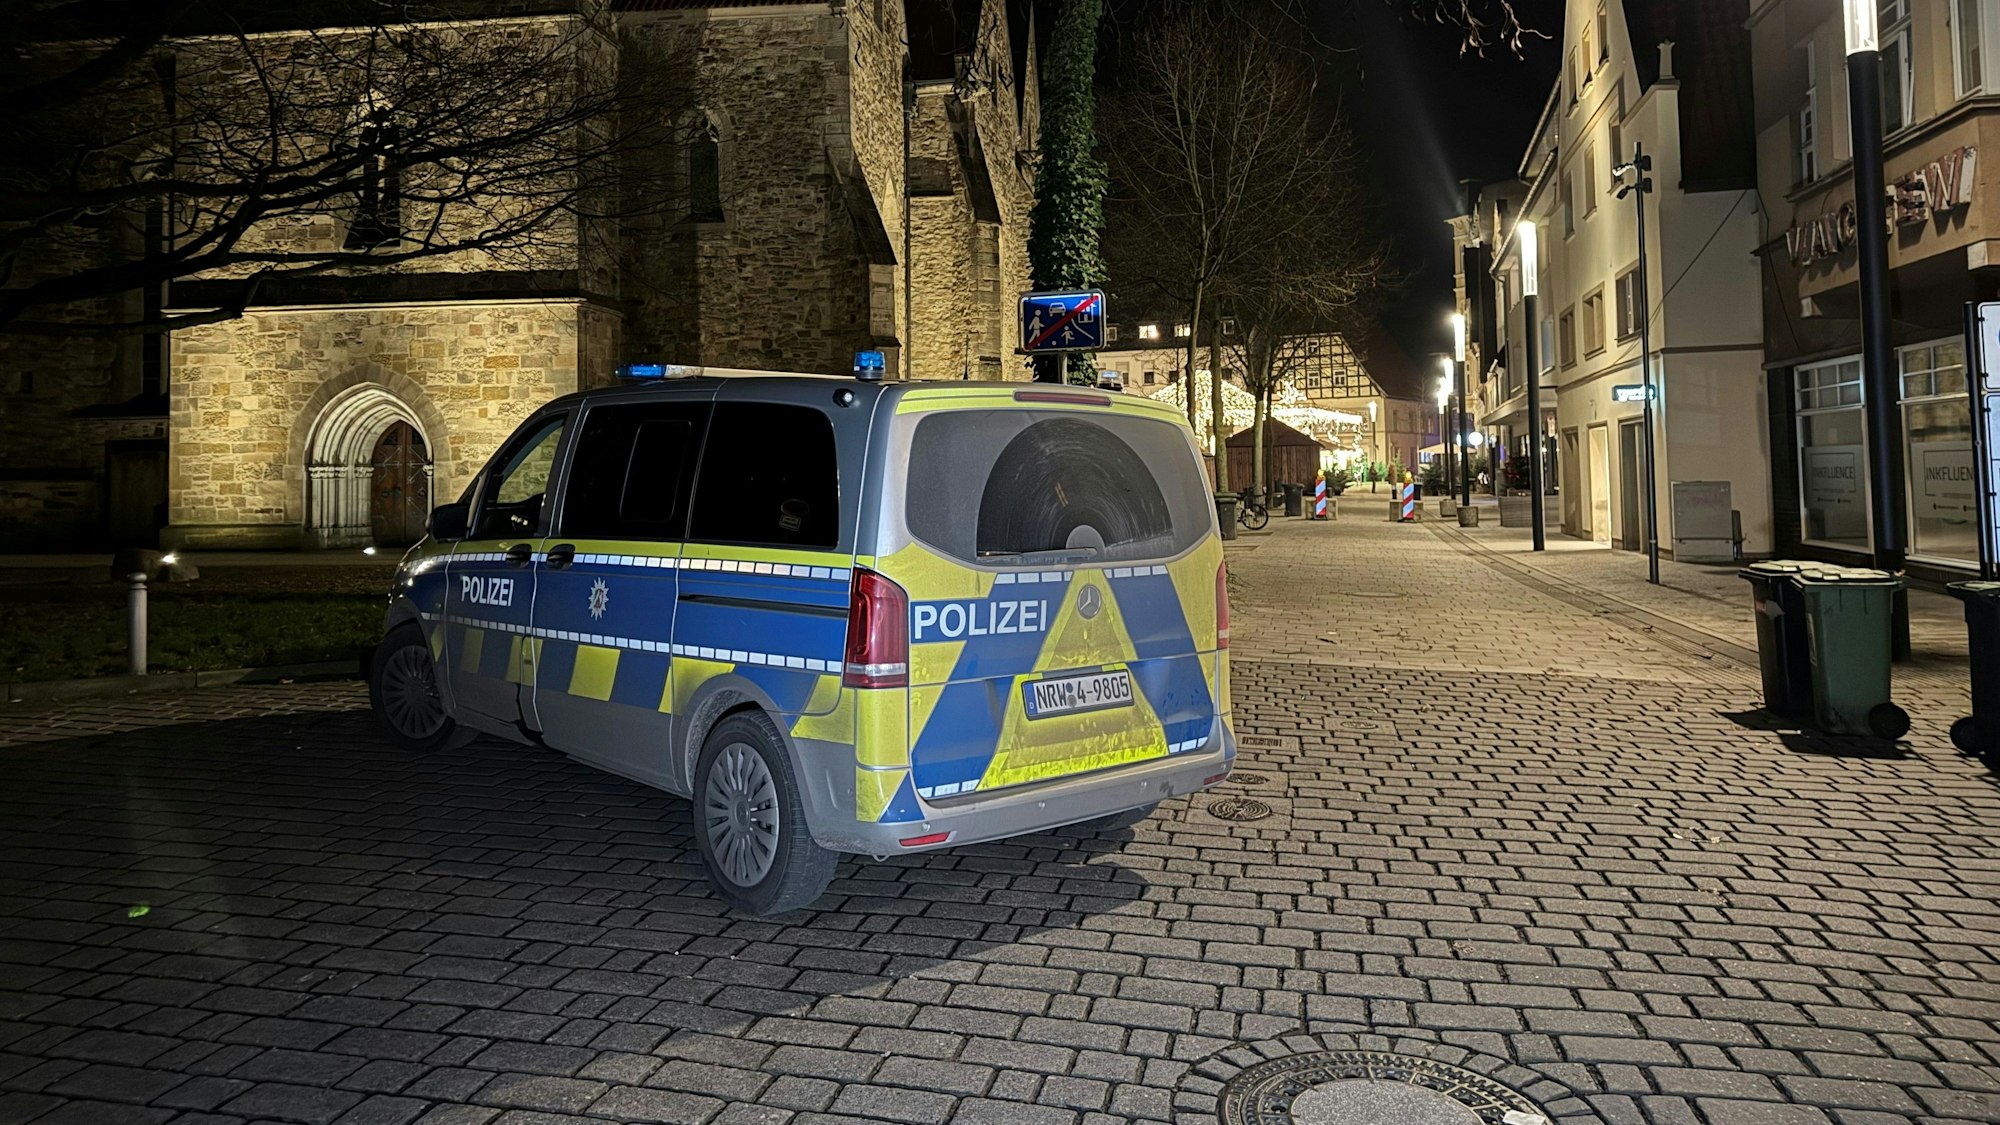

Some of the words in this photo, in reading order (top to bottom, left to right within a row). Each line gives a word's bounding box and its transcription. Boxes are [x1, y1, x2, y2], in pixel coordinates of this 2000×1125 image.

[1925, 466, 1974, 481] INKFLUEN
[461, 575, 514, 607] POLIZEI
[914, 600, 1047, 640] POLIZEI
[1035, 682, 1068, 709] NRW
[1077, 675, 1130, 704] 4-9805
